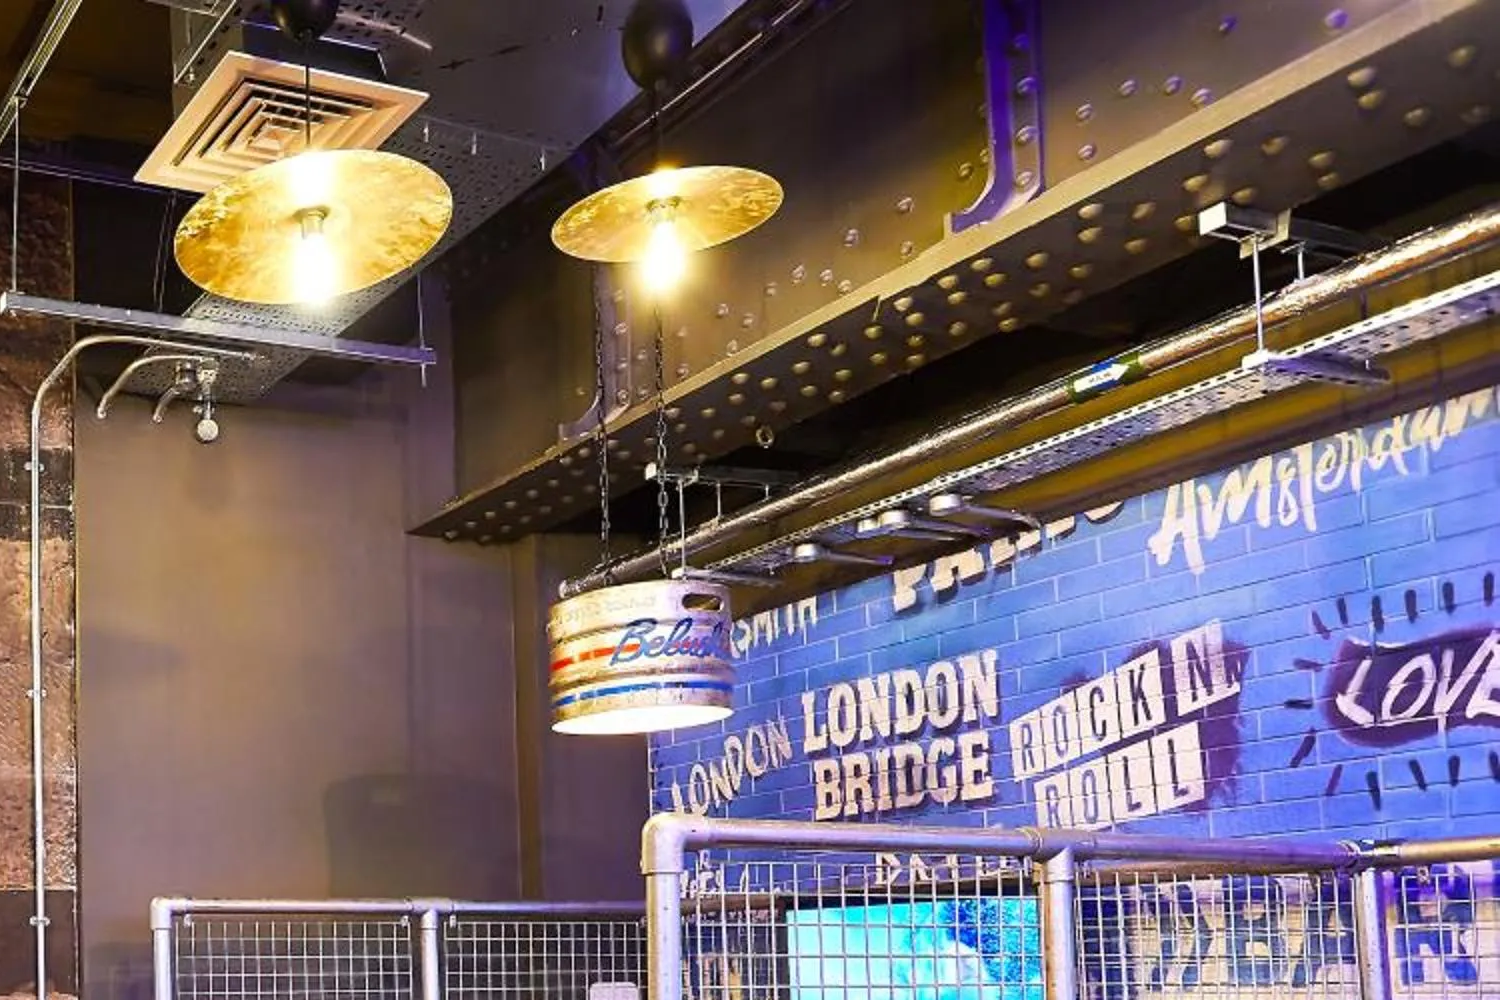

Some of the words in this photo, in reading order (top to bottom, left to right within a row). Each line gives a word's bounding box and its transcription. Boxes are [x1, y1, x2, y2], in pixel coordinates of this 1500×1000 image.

[802, 648, 999, 753] LONDON
[1019, 662, 1154, 772] ROCK
[671, 714, 792, 816] LONDON
[813, 730, 995, 821] BRIDGE
[1044, 738, 1191, 829] ROLL
